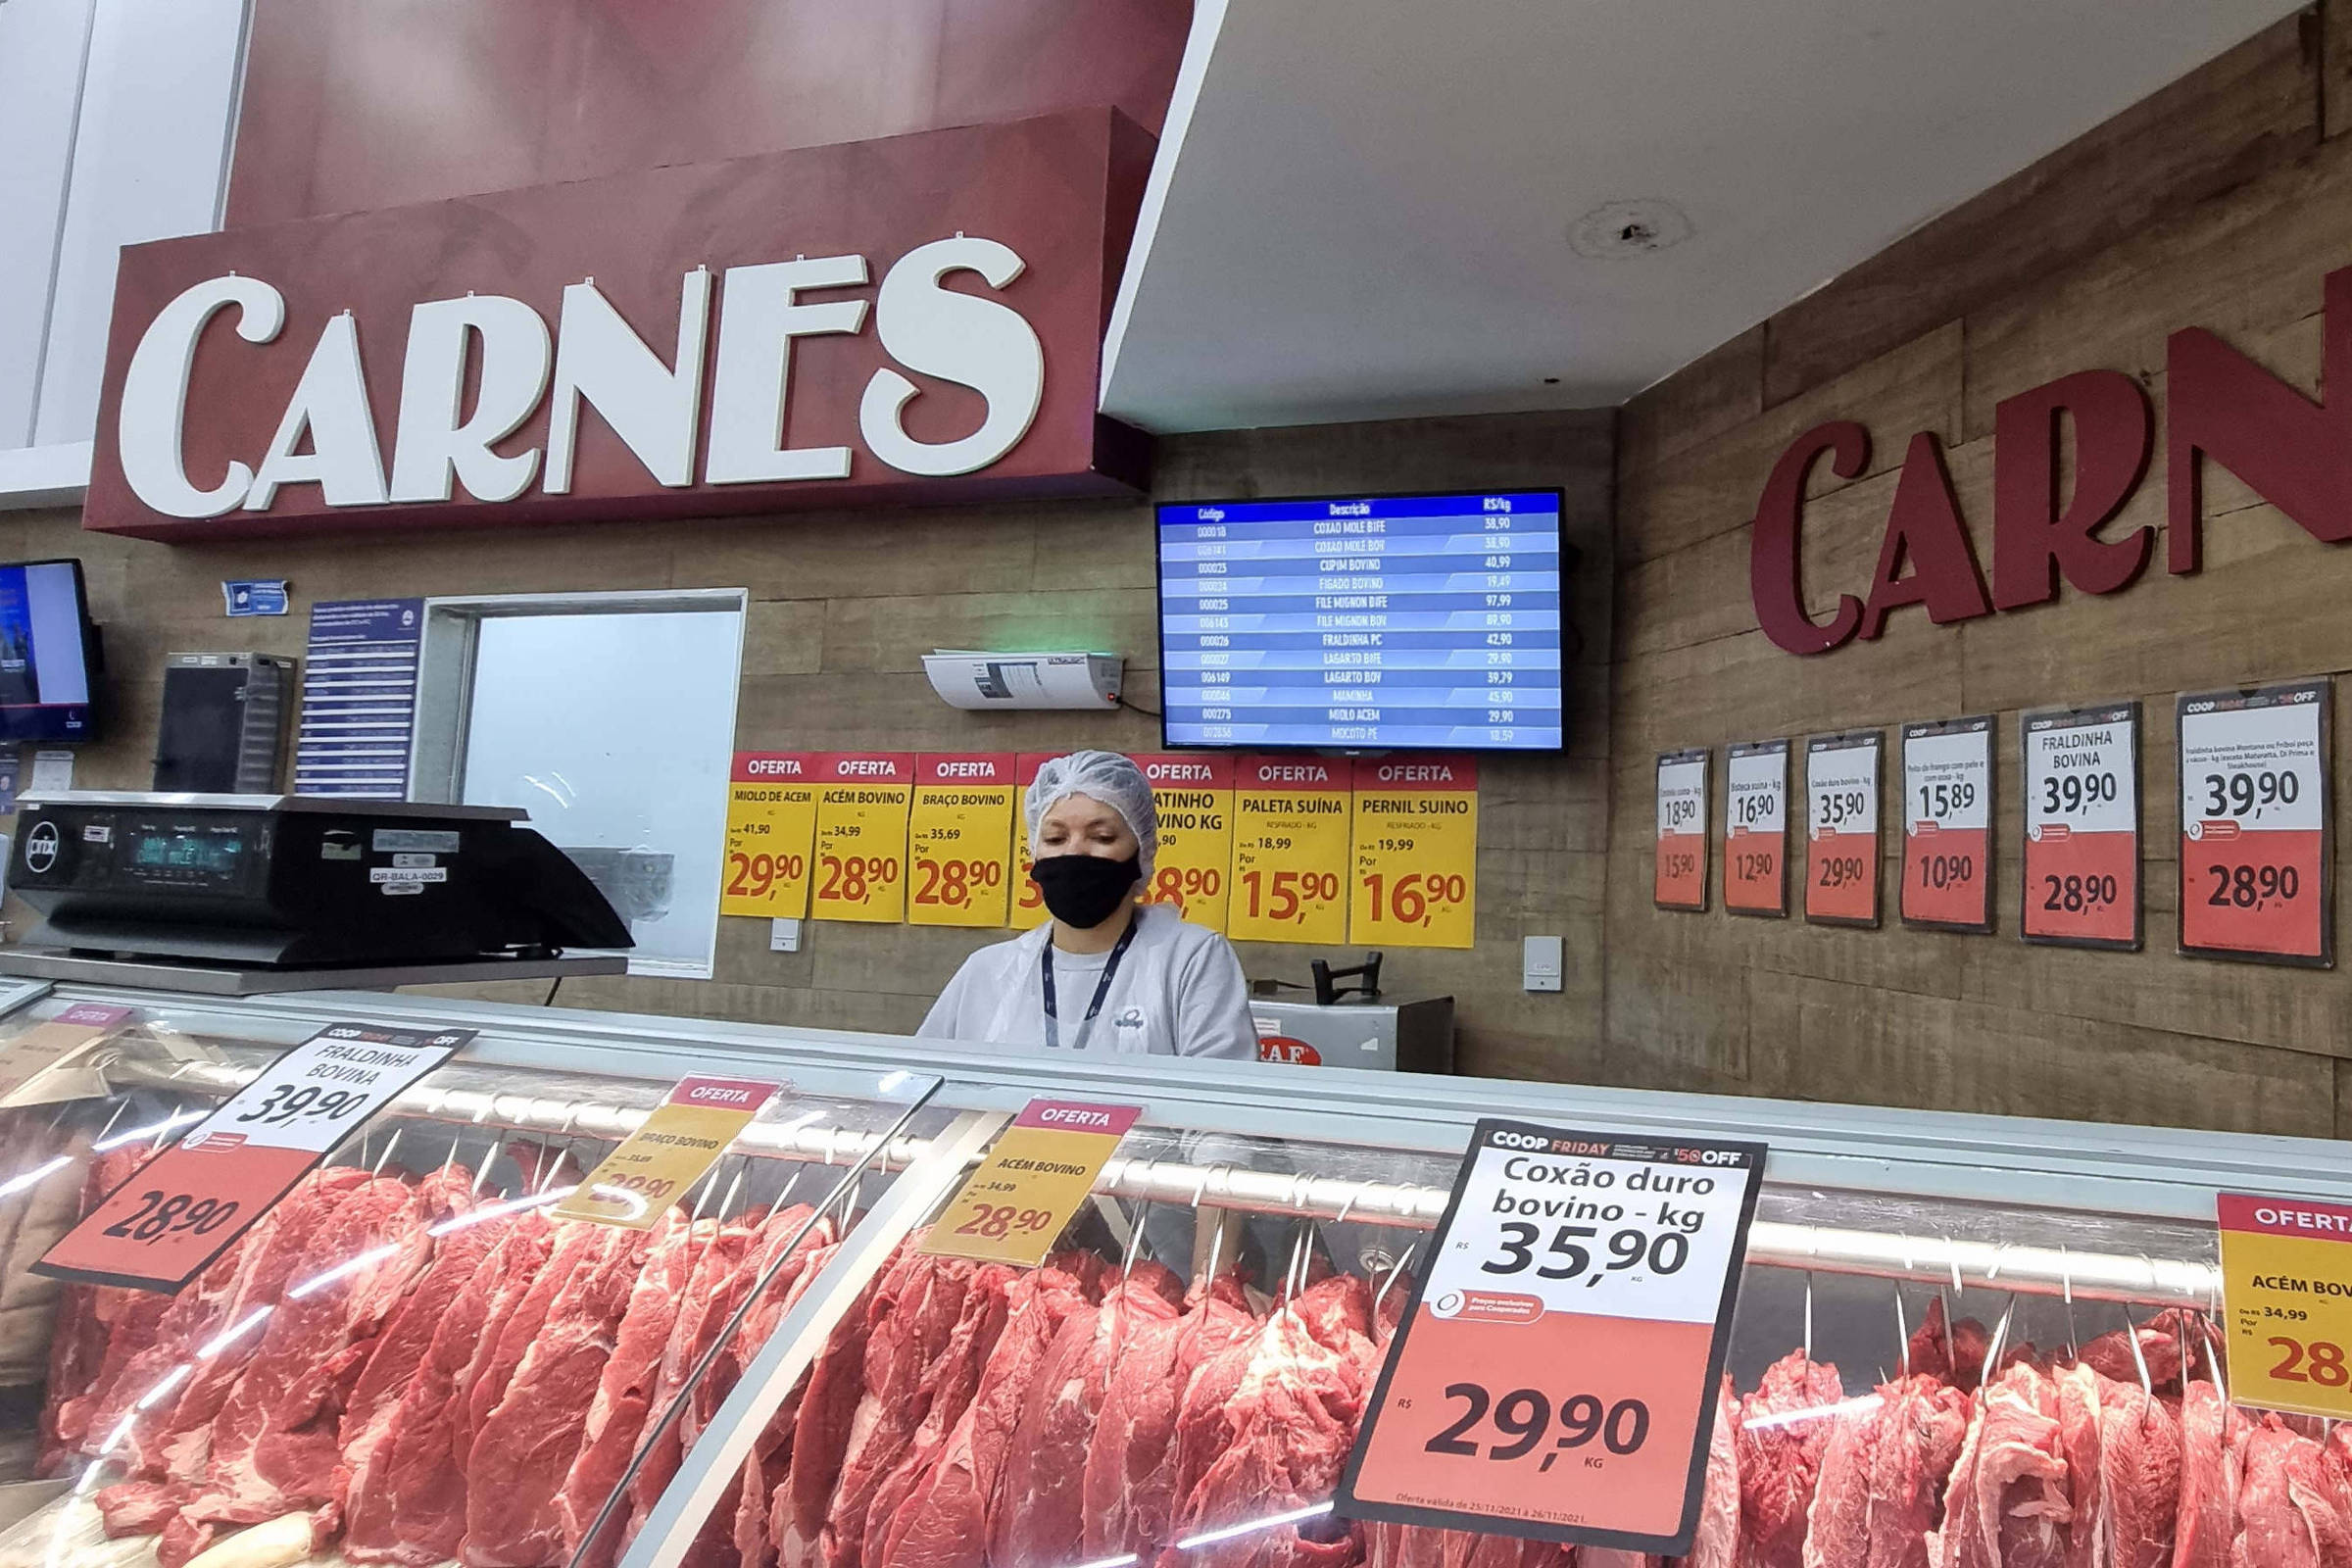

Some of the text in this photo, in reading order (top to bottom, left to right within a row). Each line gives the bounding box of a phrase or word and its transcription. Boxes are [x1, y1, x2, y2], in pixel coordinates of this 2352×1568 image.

[119, 230, 1045, 519] CARNES
[1330, 503, 1371, 516] Descrição
[1344, 521, 1364, 533] MOLE
[1367, 520, 1386, 533] BIFE
[1345, 541, 1365, 551] MOLE
[1348, 559, 1380, 570] BOVINO
[1352, 576, 1384, 589] BOVINO
[1334, 596, 1367, 608] MIGNON
[1323, 633, 1368, 646] FRALDINHA
[1323, 653, 1362, 664] LAGARTO
[1325, 670, 1362, 684] LAGARTO
[2187, 702, 2215, 713] COOP
[2293, 691, 2317, 704] OFF
[1356, 709, 1380, 721] ACEM
[1331, 727, 1366, 739] MOCOTO
[2042, 730, 2113, 751] FRALDINHA
[748, 760, 802, 774] OFERTA
[2054, 751, 2101, 768] BOVINA
[838, 760, 896, 776] OFERTA
[937, 762, 996, 776] OFERTA
[1147, 763, 1212, 780] OFERTA
[1258, 765, 1329, 781] OFERTA
[1378, 765, 1452, 782] OFERTA
[735, 790, 811, 803] MIOLO DE ACEM
[823, 790, 906, 805] ACÉM BOVINO
[923, 795, 1004, 808] BRAÇO BOVINO
[1154, 792, 1213, 808] ATINHO
[1920, 783, 1975, 820] 15,89
[2042, 772, 2117, 815] 39,90
[2205, 770, 2299, 819] 39,90
[1243, 797, 1343, 813] PALETA SUÍNA
[1362, 800, 1468, 813] PERNIL SUINO
[1738, 795, 1774, 824] 16,90
[1820, 792, 1864, 825] 35,90
[1156, 813, 1222, 829] VINO KG
[1666, 800, 1695, 827] 18,90
[743, 824, 770, 835] 41,90
[834, 826, 860, 837] 34,99
[931, 828, 960, 841] 35,69
[821, 841, 833, 851] Por
[915, 844, 929, 854] Por
[1158, 835, 1176, 847] ,90
[1258, 837, 1292, 851] 18,99
[1379, 839, 1414, 851] 19,99
[1239, 853, 1255, 863] Por
[1359, 857, 1376, 866] Por
[1737, 854, 1773, 882] 12,90
[1820, 858, 1863, 890] 29,90
[1921, 856, 1972, 892] 10,90
[726, 853, 804, 902] 29,90
[818, 857, 898, 906] 28,90
[915, 859, 1002, 909] 28,90
[1137, 866, 1221, 919] 8,90
[2044, 874, 2117, 915] 28,90
[2208, 864, 2299, 911] 28,90
[1243, 870, 1339, 925] 15,90
[1363, 874, 1466, 928] 16,90
[328, 1029, 460, 1045] COOP OFF
[314, 1045, 419, 1068] FRALDINHA
[1260, 1044, 1304, 1064] AF
[306, 1062, 380, 1086] BOVINA
[690, 1086, 752, 1103] OFERTA
[235, 1084, 370, 1129] 39,90
[1041, 1108, 1110, 1127] OFERTA
[674, 1137, 718, 1150] BOVINO
[1493, 1131, 1548, 1150] COOP
[1551, 1141, 1610, 1156] FRIDAY
[1701, 1151, 1742, 1165] OFF
[997, 1158, 1086, 1176] ACÉM BOVINO
[1504, 1156, 1715, 1196] Coxão duro
[987, 1182, 1017, 1192] 34,99
[103, 1190, 239, 1247] 28,90
[1493, 1190, 1624, 1222] bovino
[1656, 1201, 1705, 1234] kg
[2254, 1207, 2352, 1233] OFERT
[955, 1203, 1053, 1243] 28,90
[1456, 1241, 1470, 1250] R$
[1481, 1223, 1690, 1288] 35,90
[2252, 1275, 2307, 1293] ACÉM
[2264, 1306, 2308, 1321] 34,99
[1397, 1397, 1411, 1409] R$
[1424, 1383, 1650, 1472] 29,90
[1584, 1456, 1603, 1468] KG
[1396, 1493, 1425, 1503] Oferta
[1427, 1495, 1454, 1507] válida
[1455, 1499, 1467, 1509] de
